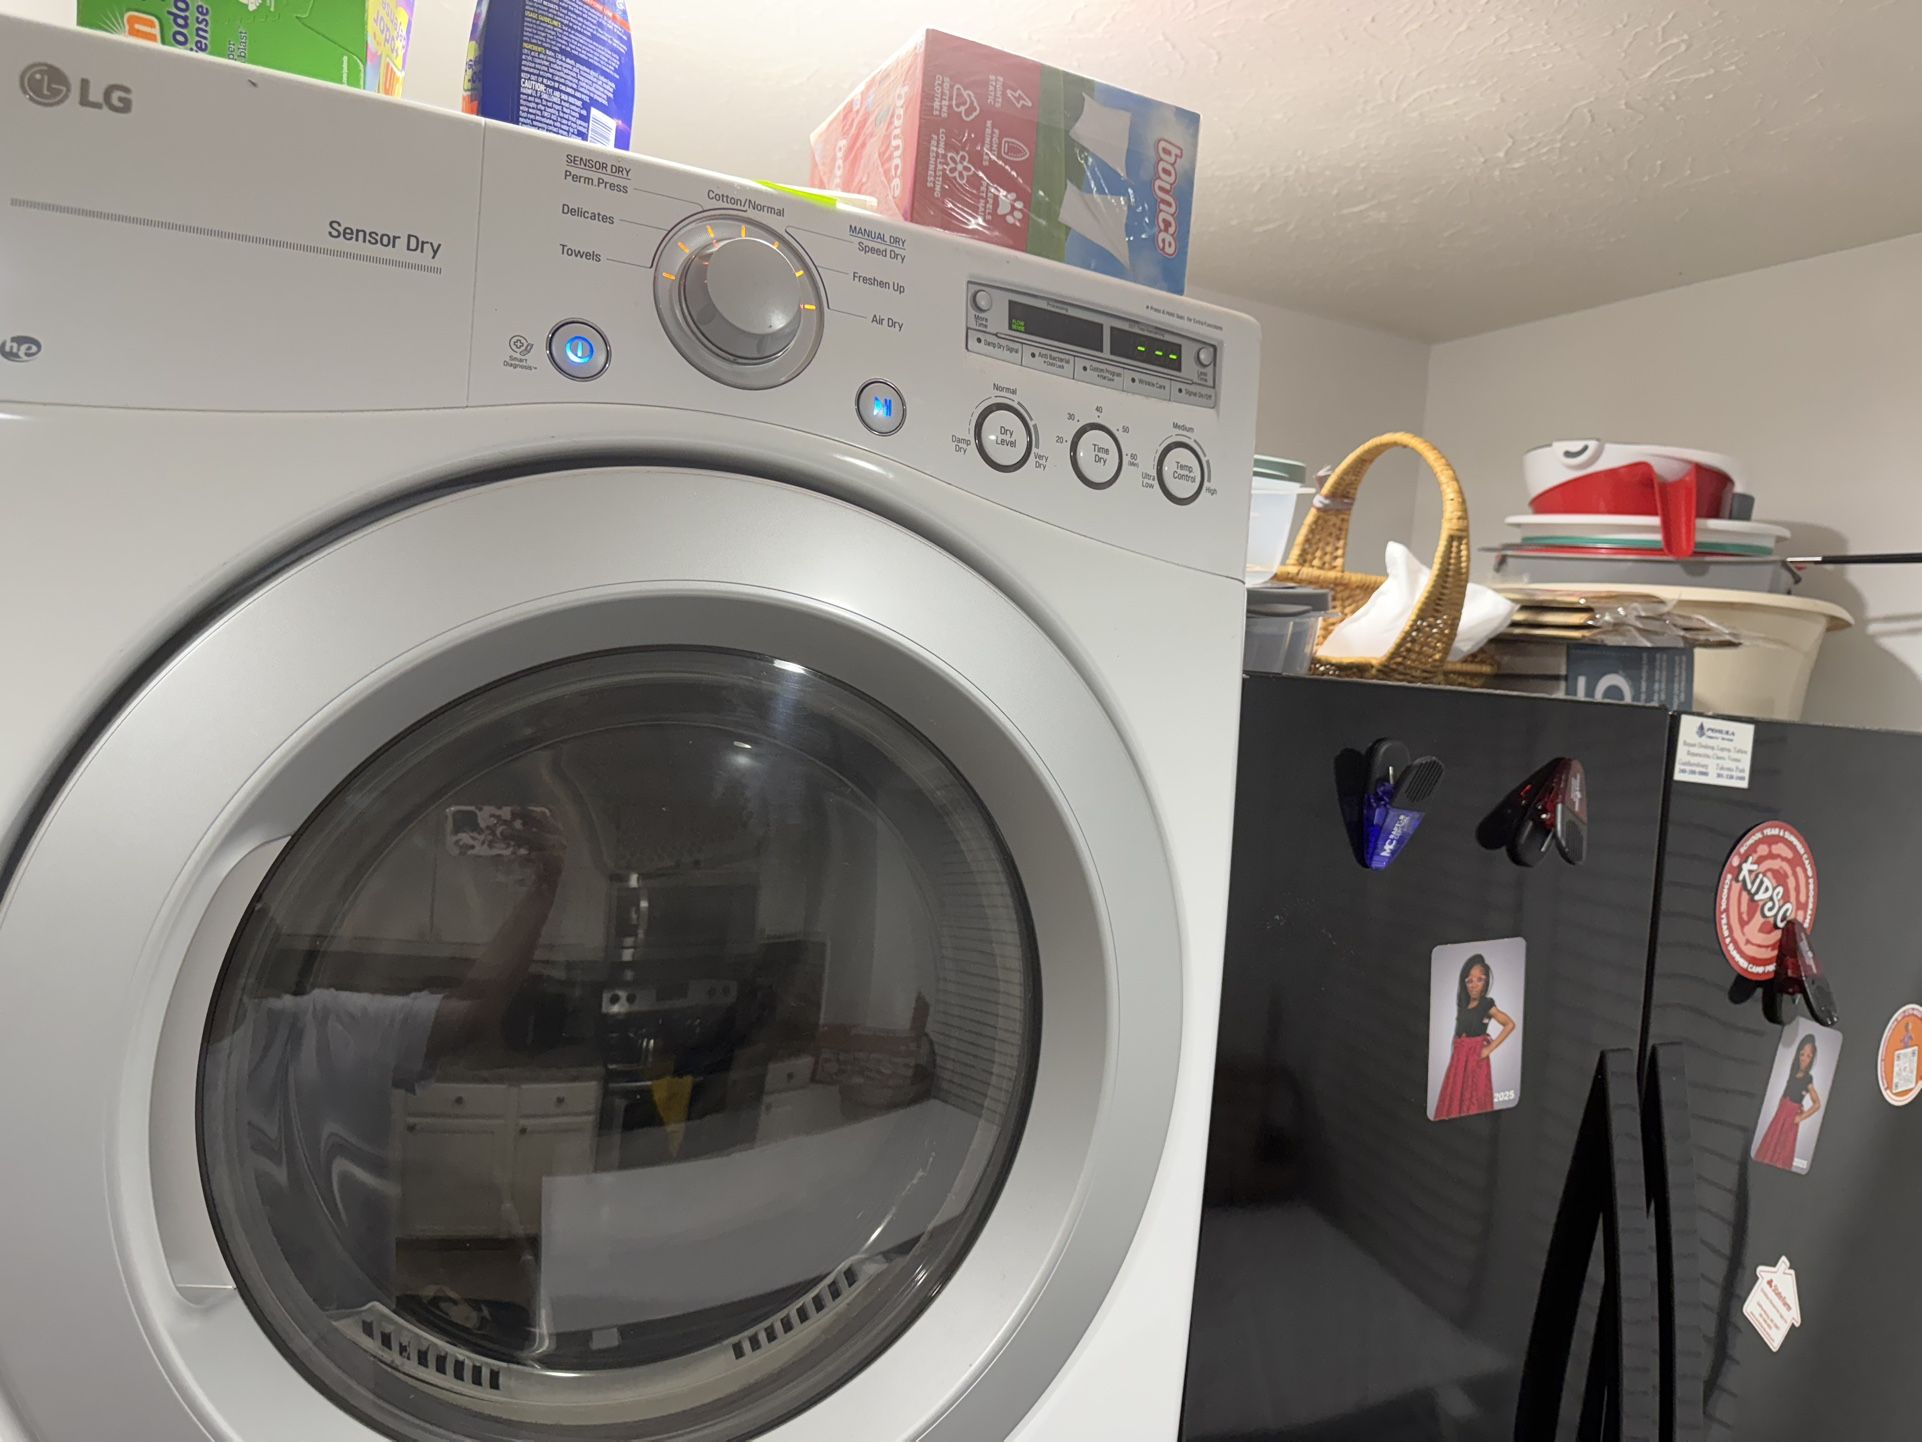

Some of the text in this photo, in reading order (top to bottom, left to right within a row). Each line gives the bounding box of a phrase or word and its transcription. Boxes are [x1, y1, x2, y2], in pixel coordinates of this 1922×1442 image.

[190, 4, 210, 53] ense
[520, 78, 545, 92] CAUTION:
[987, 74, 996, 105] STATIC
[78, 77, 133, 114] LG
[933, 74, 942, 116] CLOTHES
[889, 84, 910, 200] bounce
[565, 153, 632, 178] SENSOR DRY
[926, 134, 937, 189] FRESHNESS
[934, 128, 946, 198] LONG-LASTING
[564, 169, 629, 194] Perm.Press
[706, 189, 785, 218] Cotton/Normal
[1153, 137, 1184, 258] bounce
[561, 203, 615, 225] Delicates
[327, 220, 442, 260] Sensor Dry
[849, 224, 907, 248] MANUAL DRY
[559, 243, 602, 263] Towels
[857, 241, 907, 264] Speed Dry
[852, 271, 906, 294] Freshen Up
[870, 313, 904, 332] Air Dry
[974, 314, 988, 323] More
[975, 320, 988, 330] Time
[983, 338, 996, 349] Damp
[997, 342, 1005, 352] Dry
[508, 354, 528, 364] Smart
[992, 382, 1017, 396] Normal
[1067, 412, 1076, 421] 30
[1095, 405, 1103, 414] 40
[999, 426, 1014, 437] Dry
[1121, 425, 1130, 434] 50
[1172, 422, 1194, 434] Medium
[951, 434, 971, 446] Damp
[995, 436, 1017, 448] Level
[1056, 435, 1064, 444] 20
[954, 445, 967, 455] Dry
[1034, 451, 1049, 462] Very
[1092, 443, 1110, 456] Time
[1035, 461, 1047, 471] Dry
[1094, 454, 1108, 467] Dry
[1175, 461, 1194, 474] Temp.
[1141, 472, 1156, 482] Ultra
[1172, 470, 1196, 483] Control
[1141, 480, 1155, 489] Low
[1205, 486, 1218, 496] High
[1763, 827, 1780, 838] YEAR
[1784, 830, 1805, 856] SUMMER
[1802, 853, 1814, 880] CAMP
[1738, 856, 1793, 929] KIDSC
[1720, 912, 1728, 938] YEAR
[1727, 943, 1748, 968] SUMMER
[1748, 964, 1765, 974] CAMP
[1493, 1089, 1515, 1102] 2025
